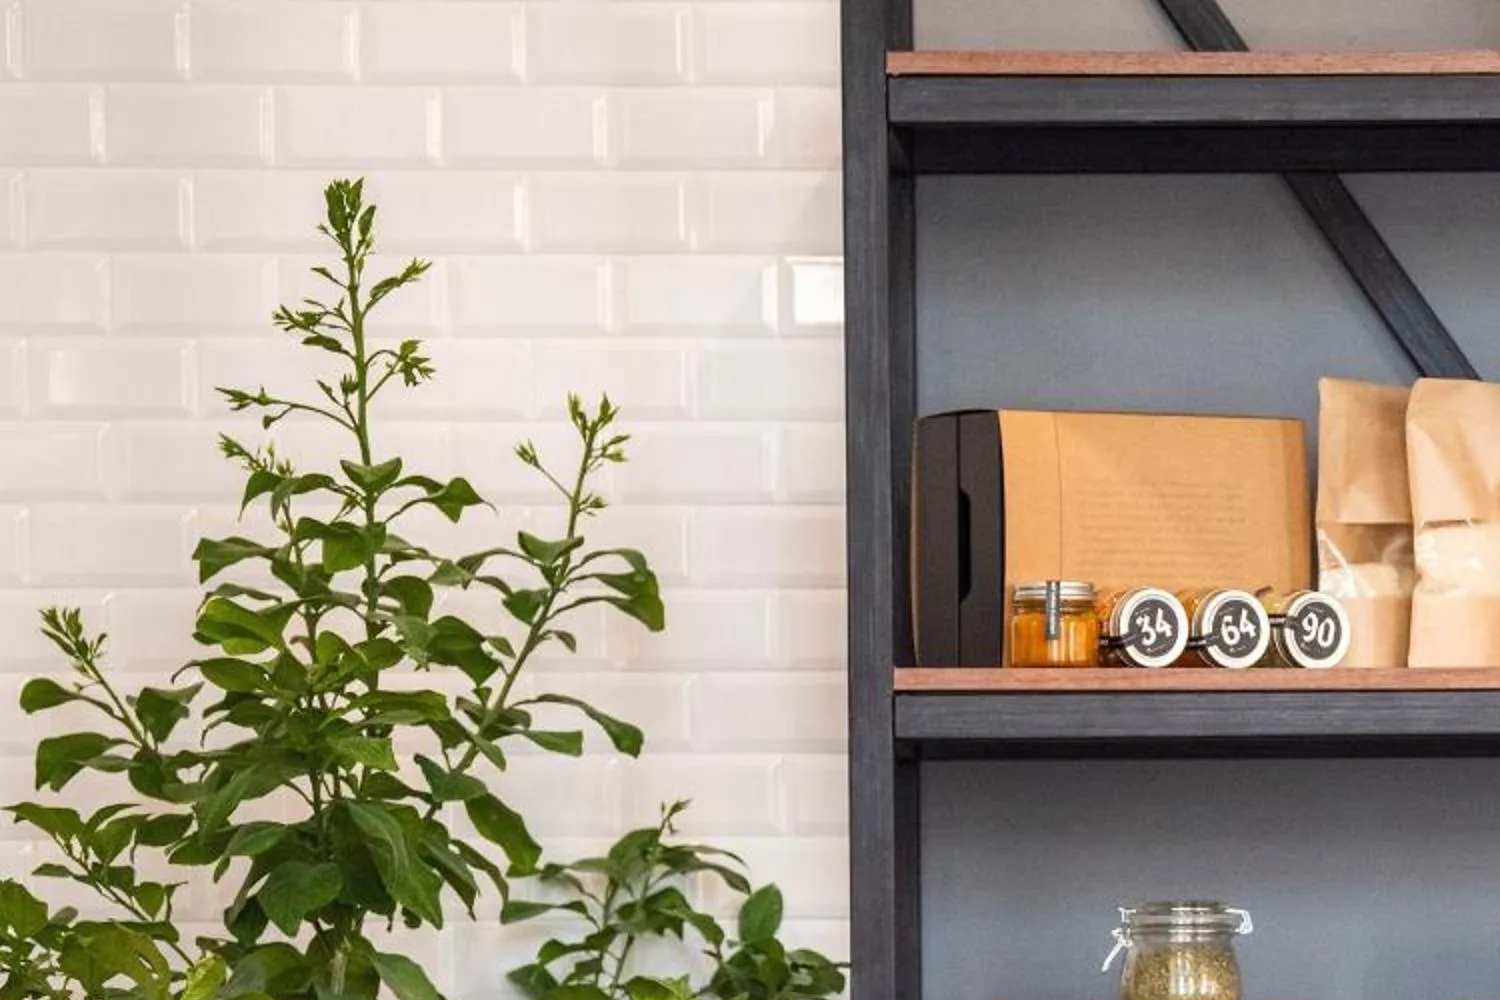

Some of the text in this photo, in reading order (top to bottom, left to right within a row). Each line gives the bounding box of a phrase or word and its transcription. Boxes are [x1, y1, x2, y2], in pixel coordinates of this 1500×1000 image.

[1135, 607, 1173, 646] 34
[1221, 608, 1257, 646] 64
[1302, 612, 1335, 648] 90
